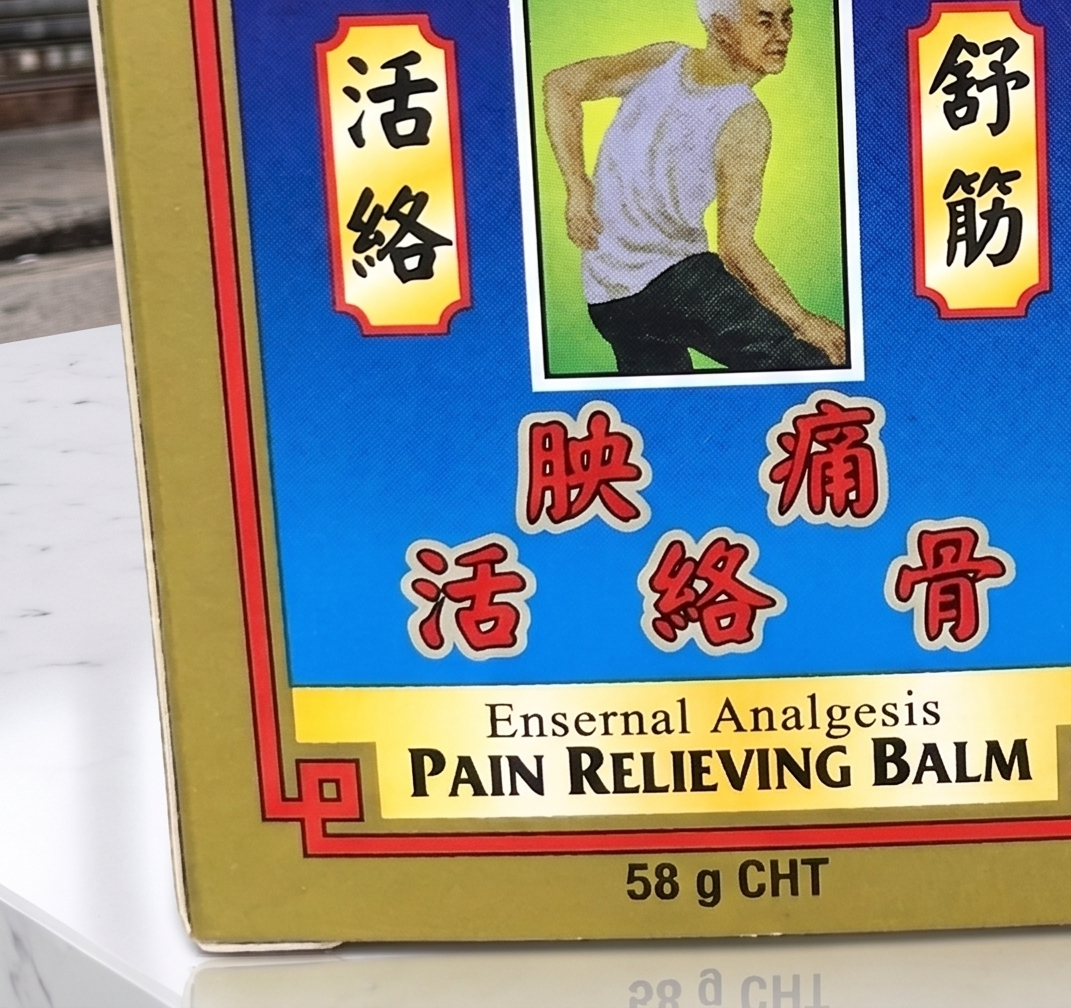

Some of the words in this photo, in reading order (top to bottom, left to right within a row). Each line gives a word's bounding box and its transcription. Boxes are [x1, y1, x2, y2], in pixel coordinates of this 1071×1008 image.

[342, 50, 453, 283] 活絡
[929, 34, 1030, 268] 舒筋
[411, 527, 1006, 651] 活絡骨
[485, 697, 690, 738] Ensernal
[710, 689, 941, 739] Analgesis
[408, 747, 545, 797] PAIN
[566, 743, 851, 795] RELIEVING
[871, 737, 1033, 786] BALM
[626, 862, 680, 901] 58
[696, 869, 721, 908] g
[738, 857, 830, 898] CHT
